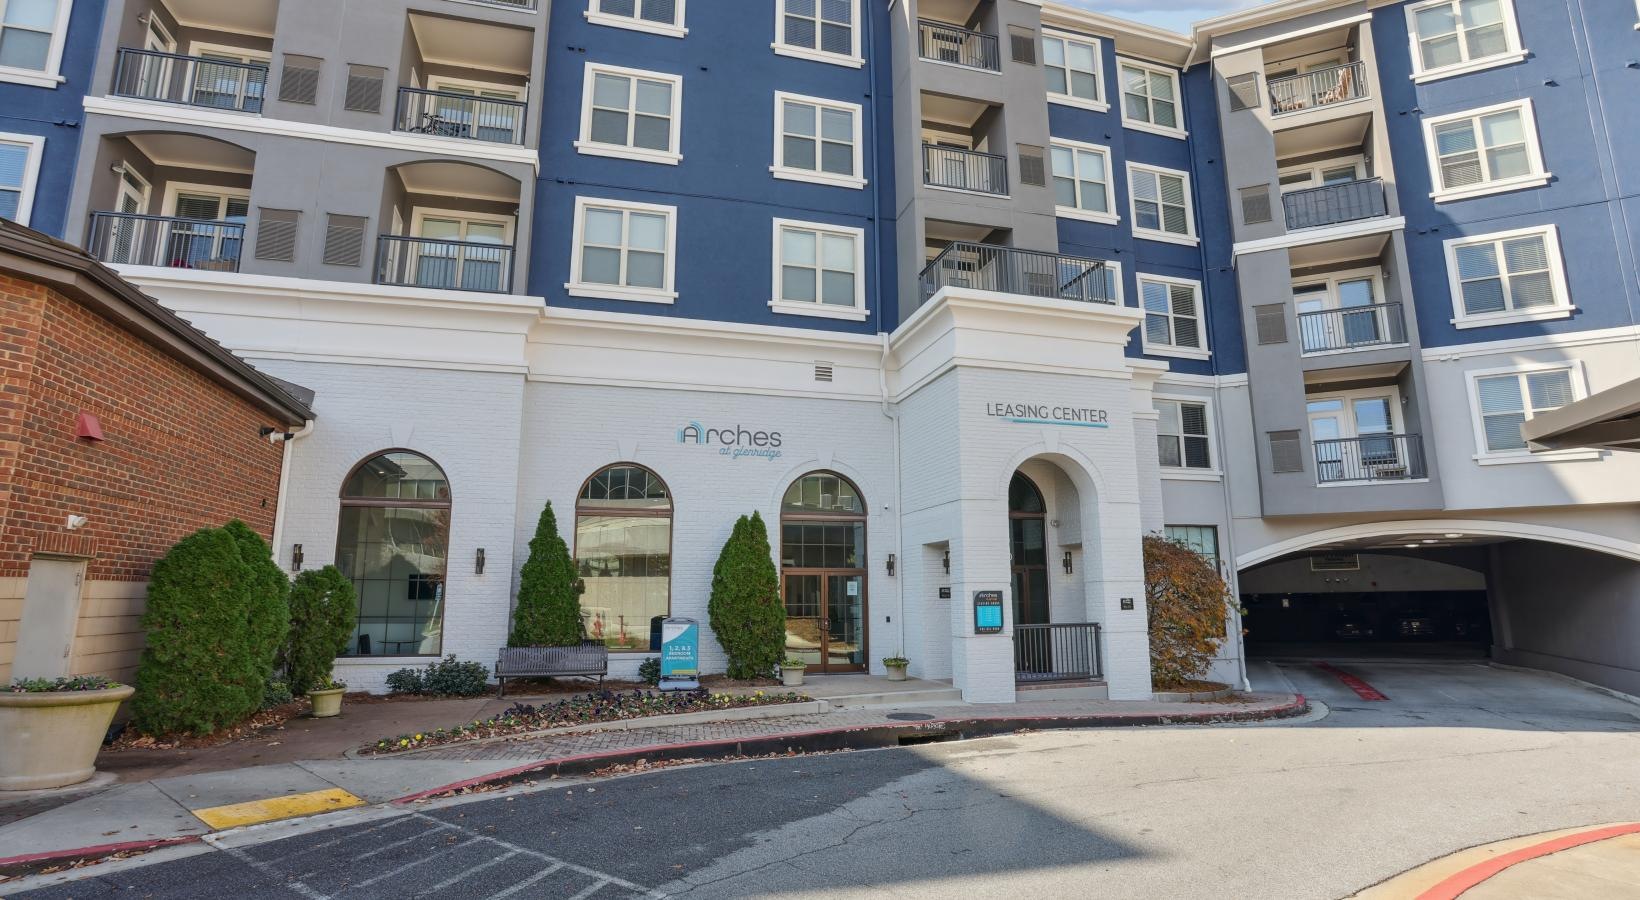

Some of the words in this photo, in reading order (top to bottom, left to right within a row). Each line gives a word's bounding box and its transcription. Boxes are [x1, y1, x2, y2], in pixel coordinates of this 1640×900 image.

[986, 402, 1049, 419] LEASING
[1052, 406, 1108, 423] CENTER
[680, 423, 782, 447] Arches
[719, 447, 731, 455] at
[733, 446, 782, 461] glenridge
